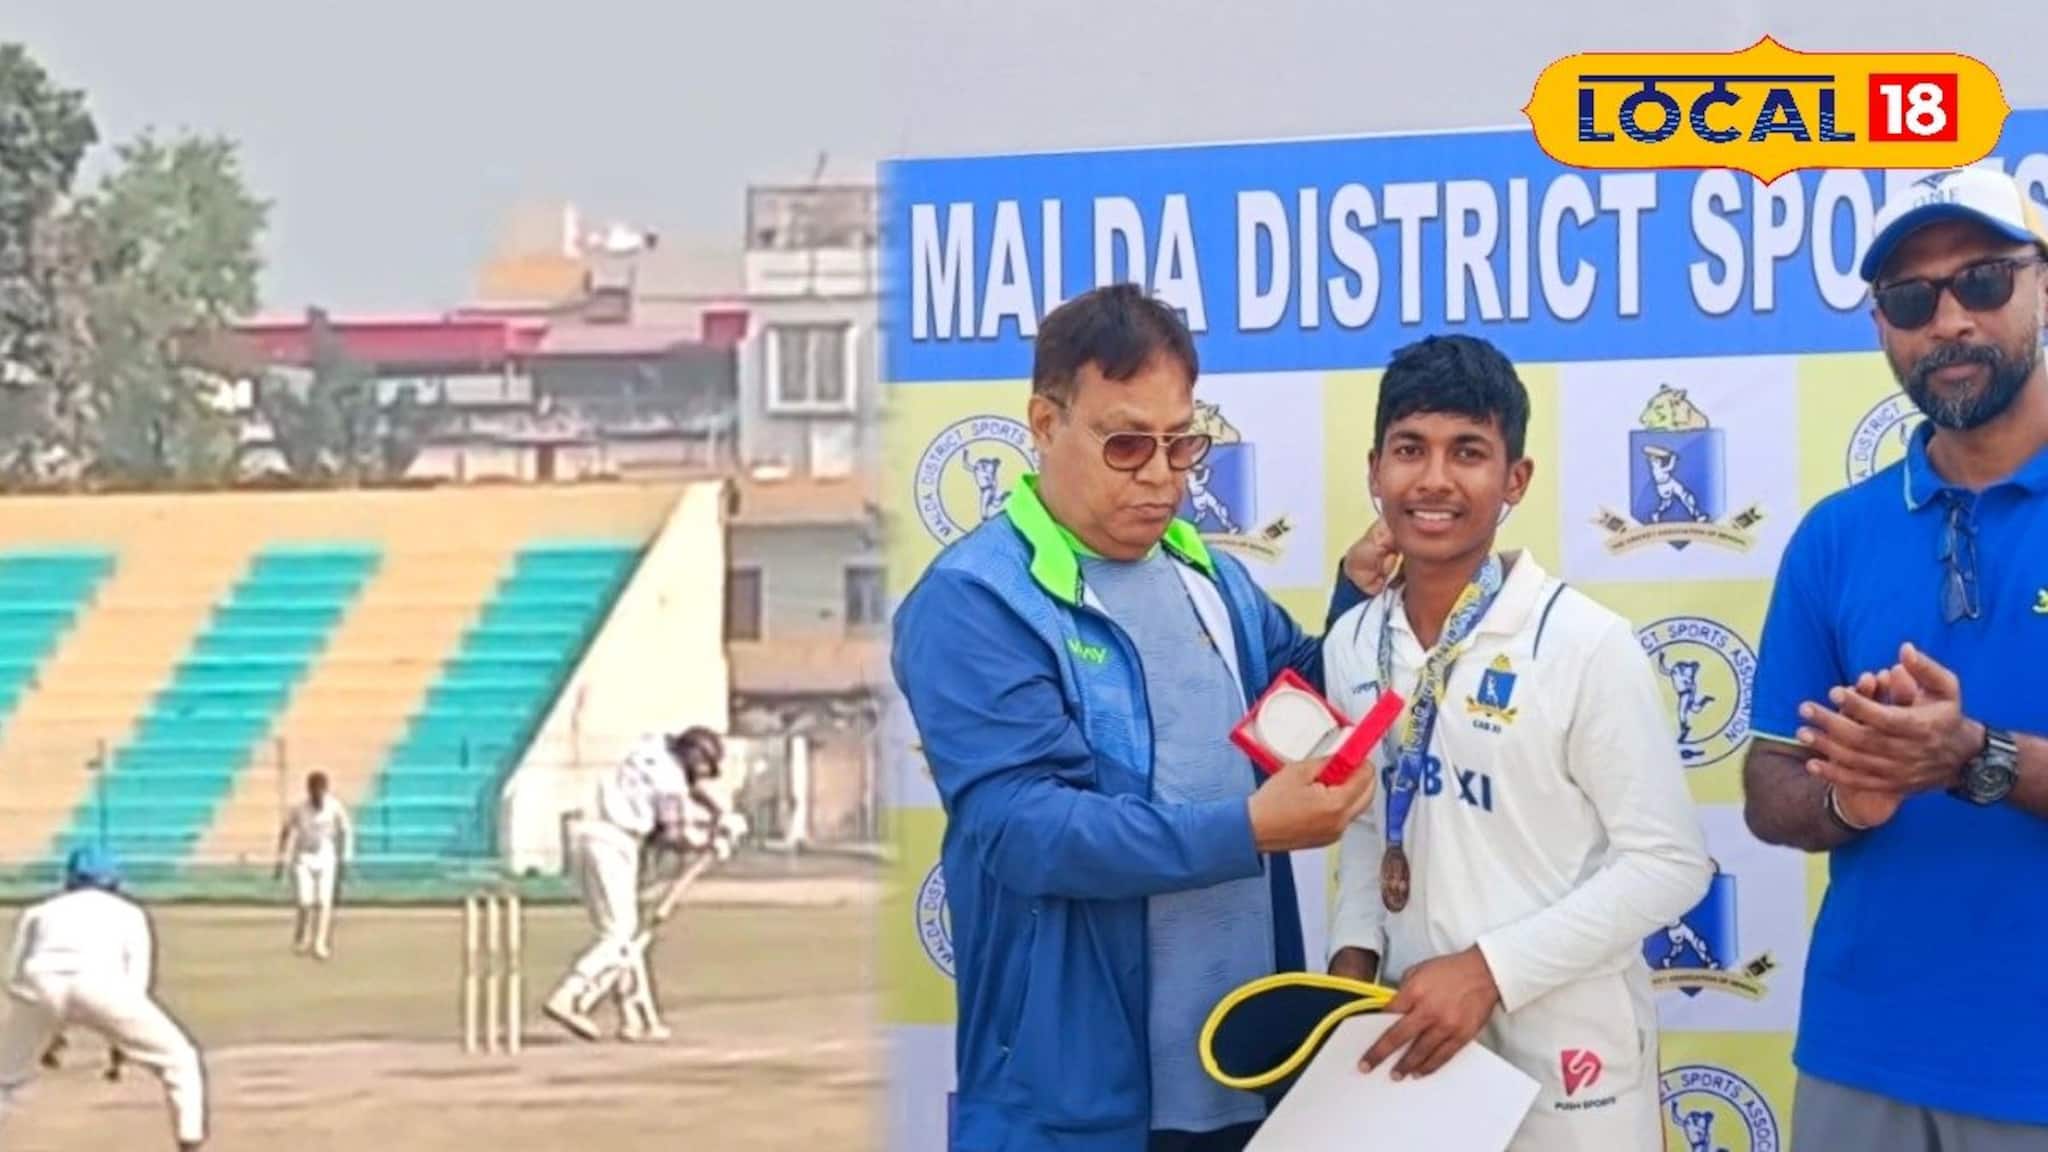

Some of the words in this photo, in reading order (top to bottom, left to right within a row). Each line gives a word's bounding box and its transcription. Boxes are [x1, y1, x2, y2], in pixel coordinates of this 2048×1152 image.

[911, 192, 1208, 339] MALDA
[1237, 172, 1657, 330] DISTRICT
[972, 421, 1026, 445] SPORTS
[1667, 623, 1729, 649] SPORTS
[1454, 765, 1492, 812] XI
[1681, 1072, 1741, 1099] SPORTS
